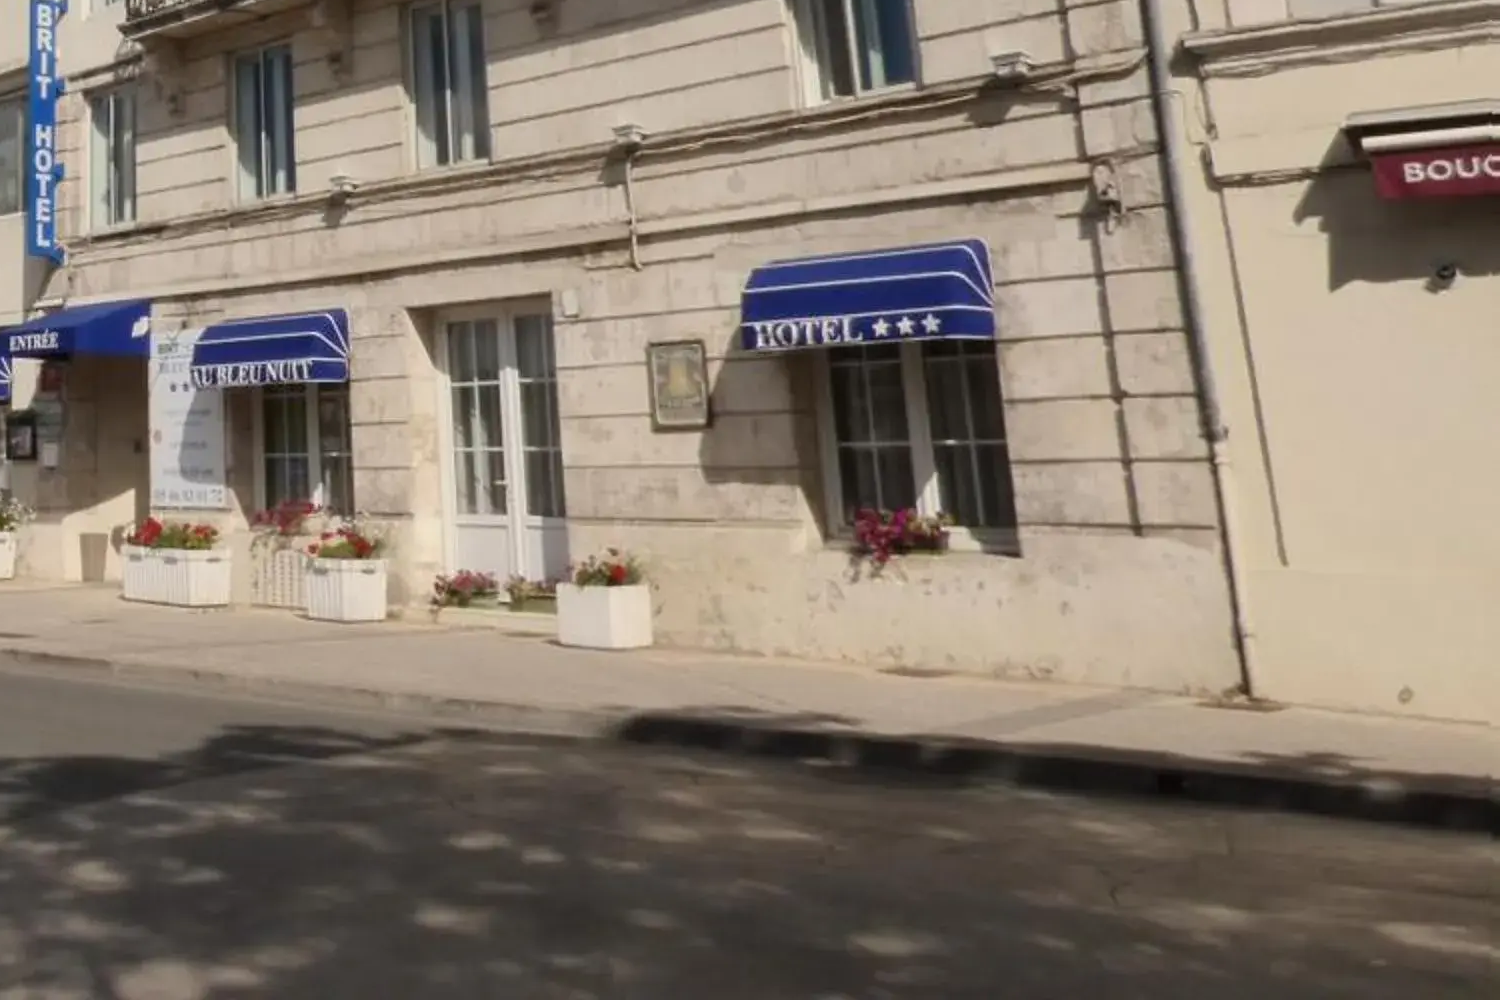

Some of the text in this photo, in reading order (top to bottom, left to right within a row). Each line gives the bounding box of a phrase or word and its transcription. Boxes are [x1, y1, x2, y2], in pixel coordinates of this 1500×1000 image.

[35, 4, 53, 248] BRIT HOTEL
[9, 328, 59, 351] ENTRÉE
[753, 317, 864, 348] HOTEL
[217, 361, 263, 385] BLEU
[265, 359, 313, 382] NUIT
